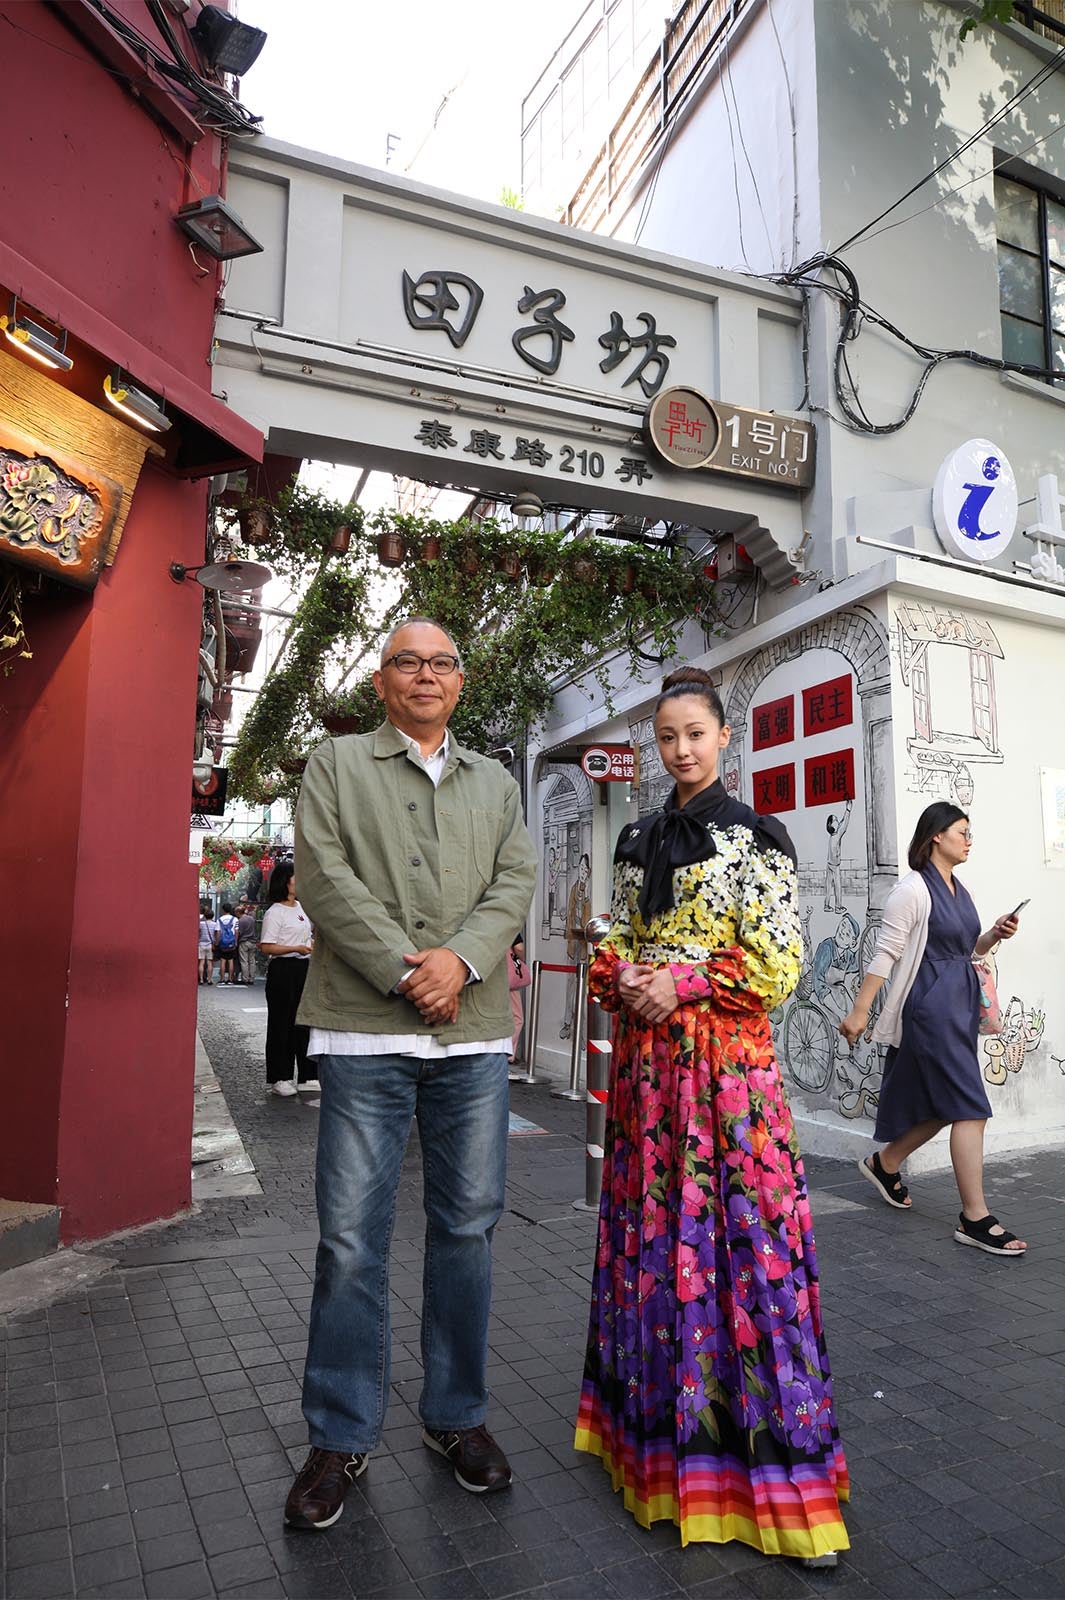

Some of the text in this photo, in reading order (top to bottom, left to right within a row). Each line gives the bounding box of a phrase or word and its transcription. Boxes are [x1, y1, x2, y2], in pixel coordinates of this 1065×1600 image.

[402, 269, 677, 397] 田子坊
[725, 415, 809, 463] 1号门
[731, 453, 799, 479] EXIT NO.1
[758, 706, 789, 741] 富强
[809, 688, 845, 726] 民主
[611, 753, 634, 765] 公用
[611, 766, 634, 777] 电话
[758, 774, 790, 805] 文明
[811, 760, 847, 797] 和谐
